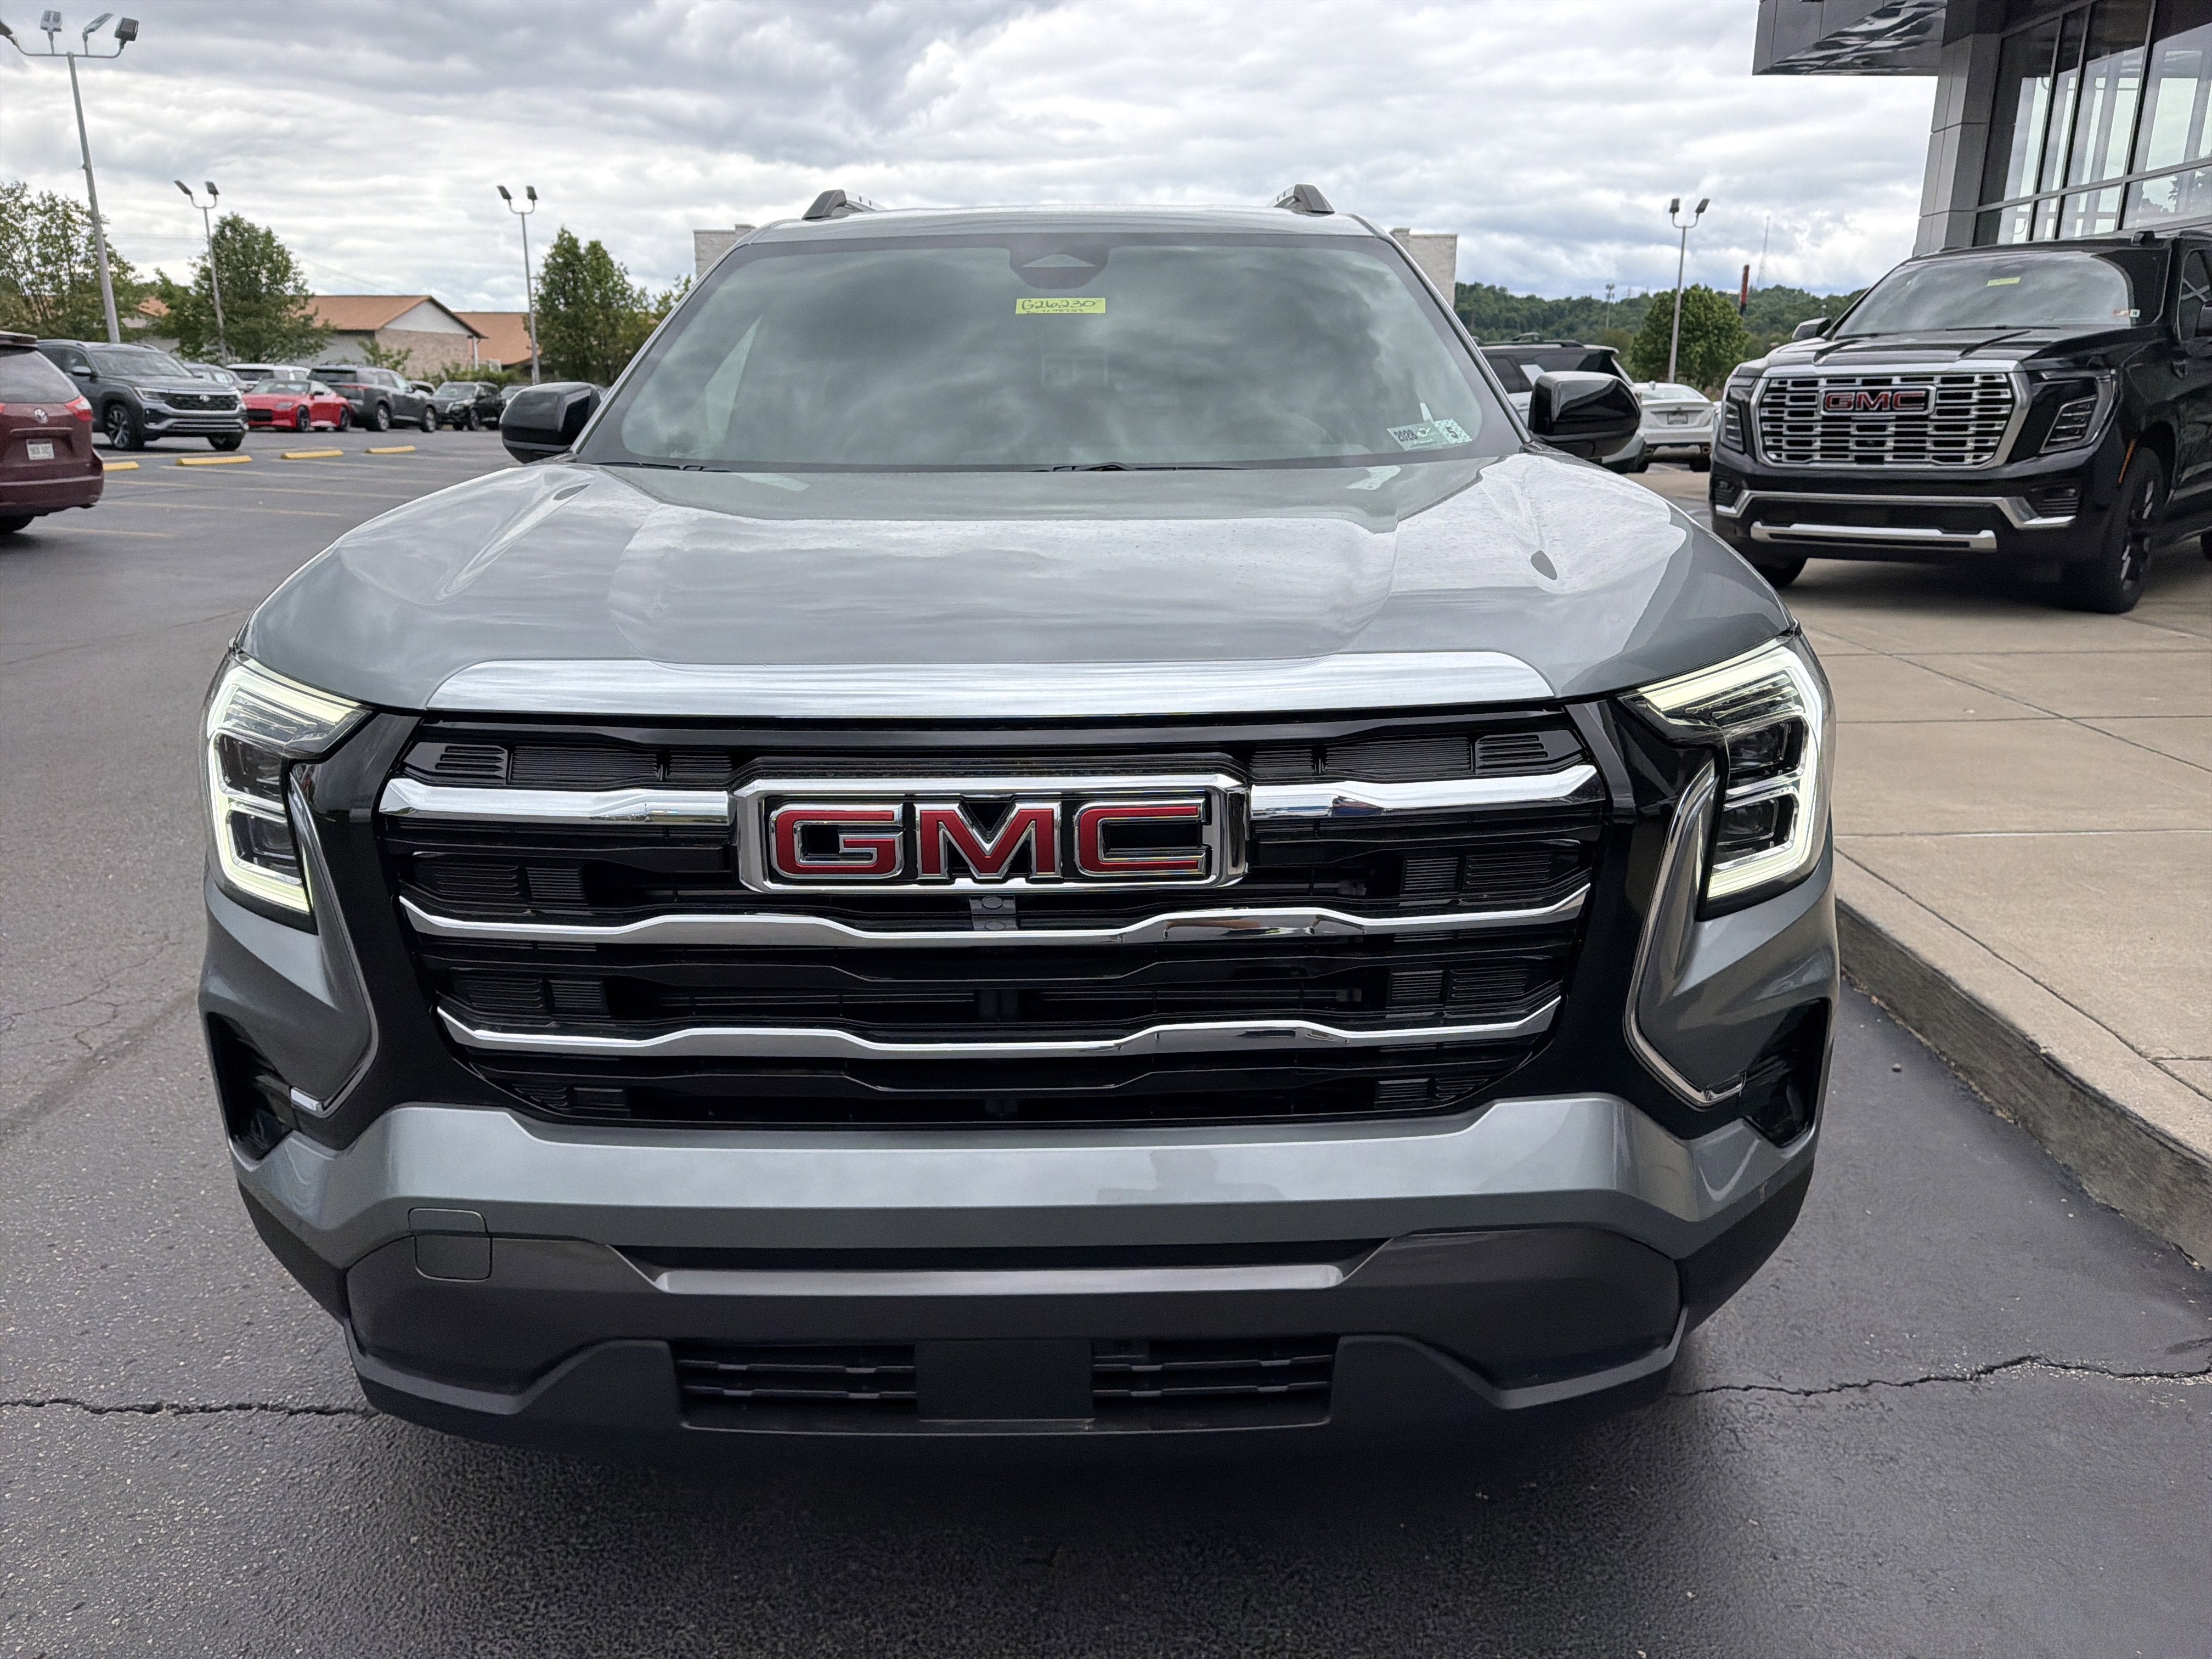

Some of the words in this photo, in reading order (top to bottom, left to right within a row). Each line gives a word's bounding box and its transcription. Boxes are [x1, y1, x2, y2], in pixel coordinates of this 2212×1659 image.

[1022, 300, 1097, 310] G26230
[1825, 391, 1926, 410] GMC
[1444, 426, 1459, 438] 5
[770, 801, 1206, 880] GMC
